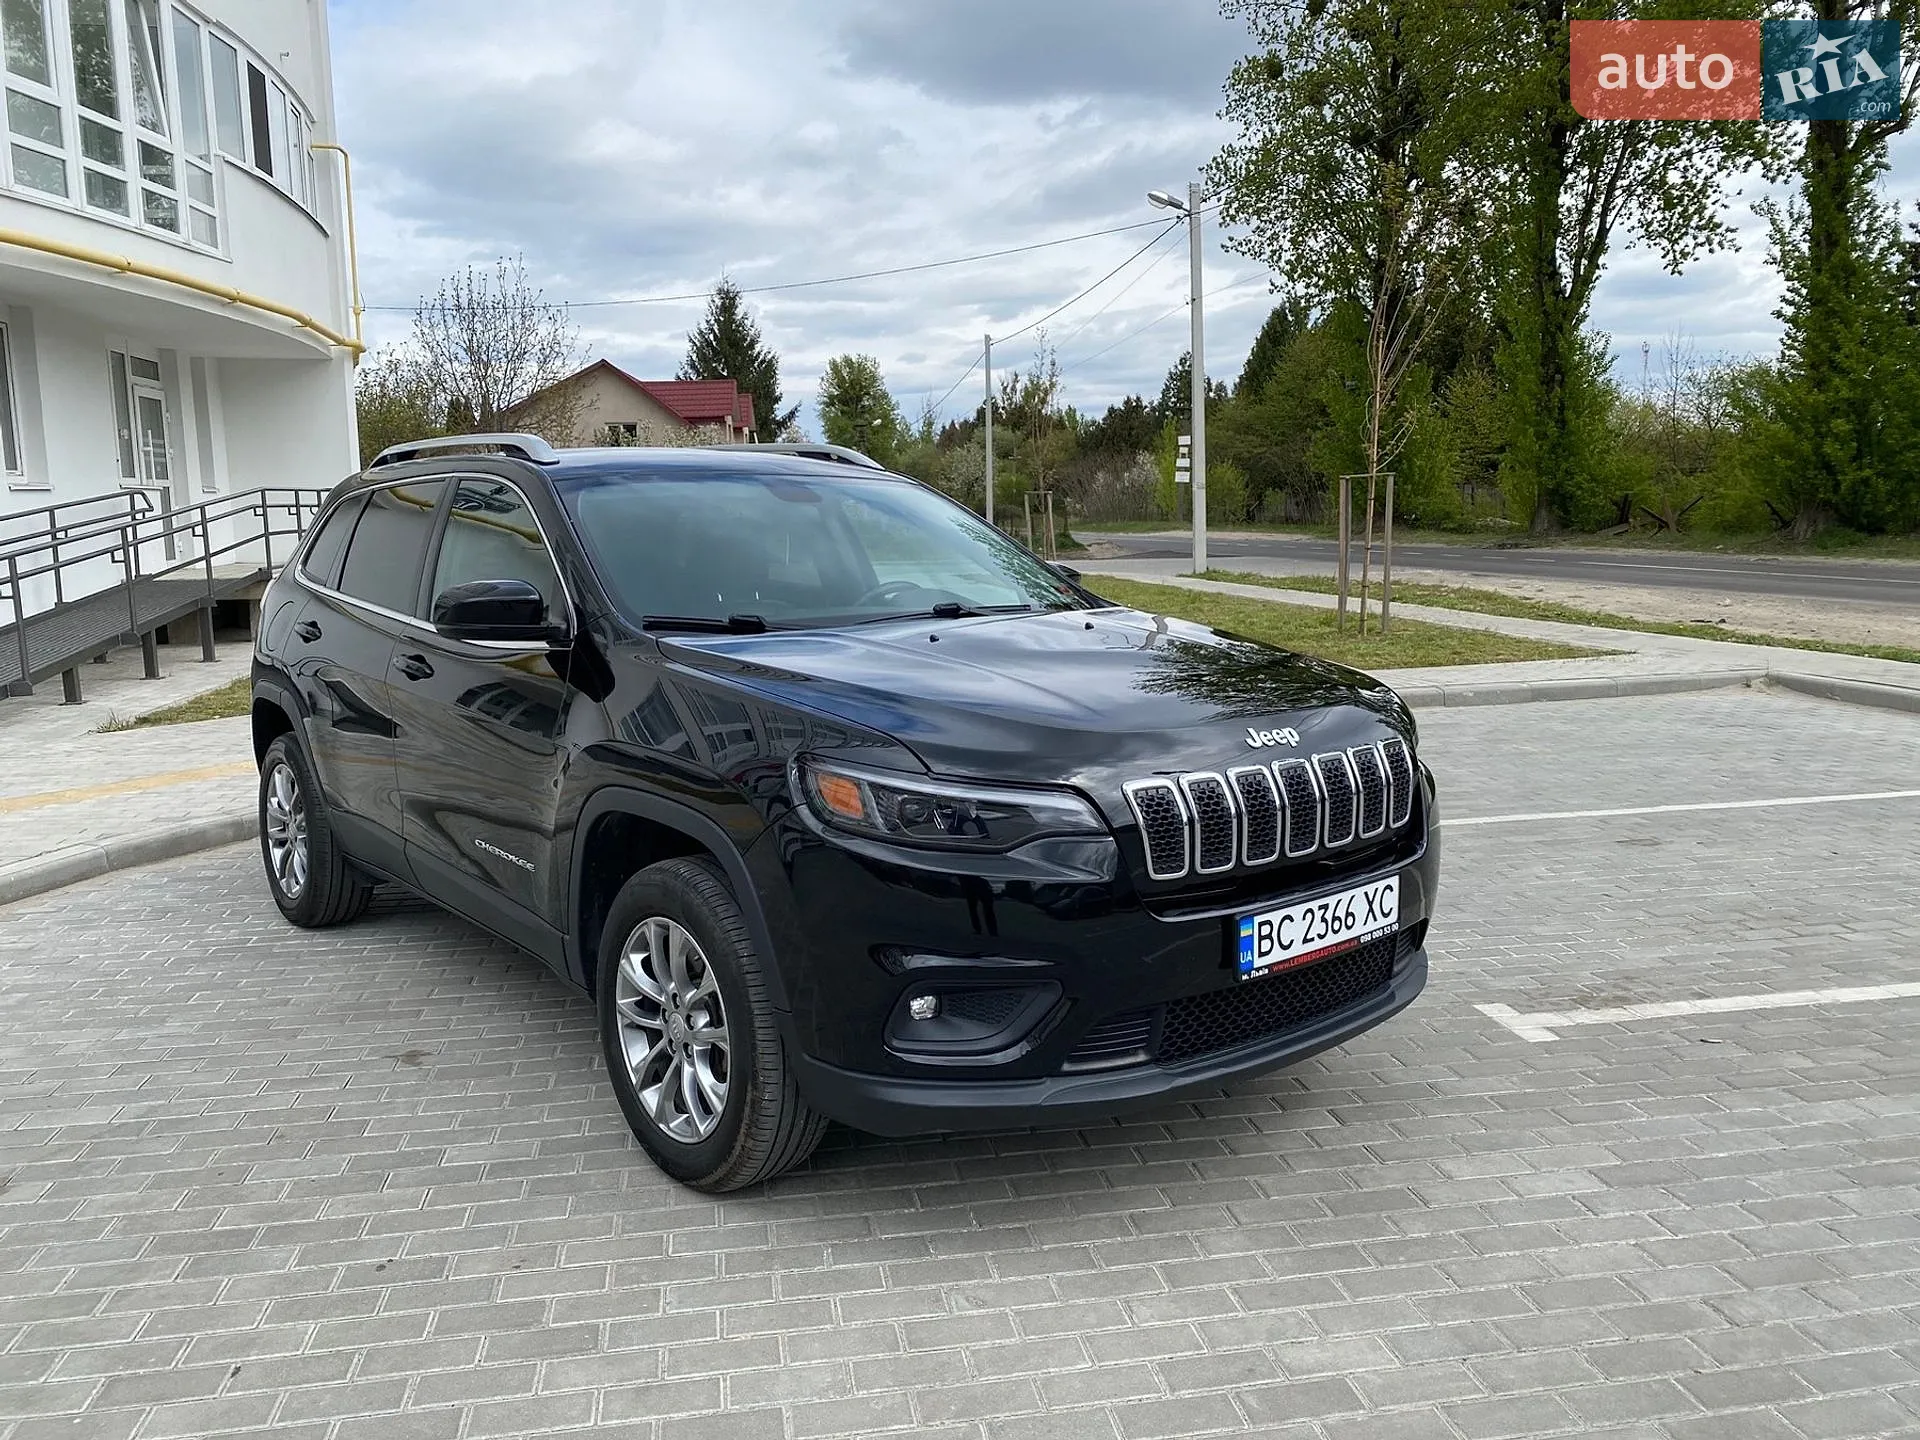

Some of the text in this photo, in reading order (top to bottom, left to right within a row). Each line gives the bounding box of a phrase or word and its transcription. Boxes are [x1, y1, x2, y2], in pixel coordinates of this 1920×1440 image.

[1244, 726, 1301, 749] Jeep
[1257, 883, 1394, 958] BC 2366 XC
[1239, 949, 1253, 964] UA
